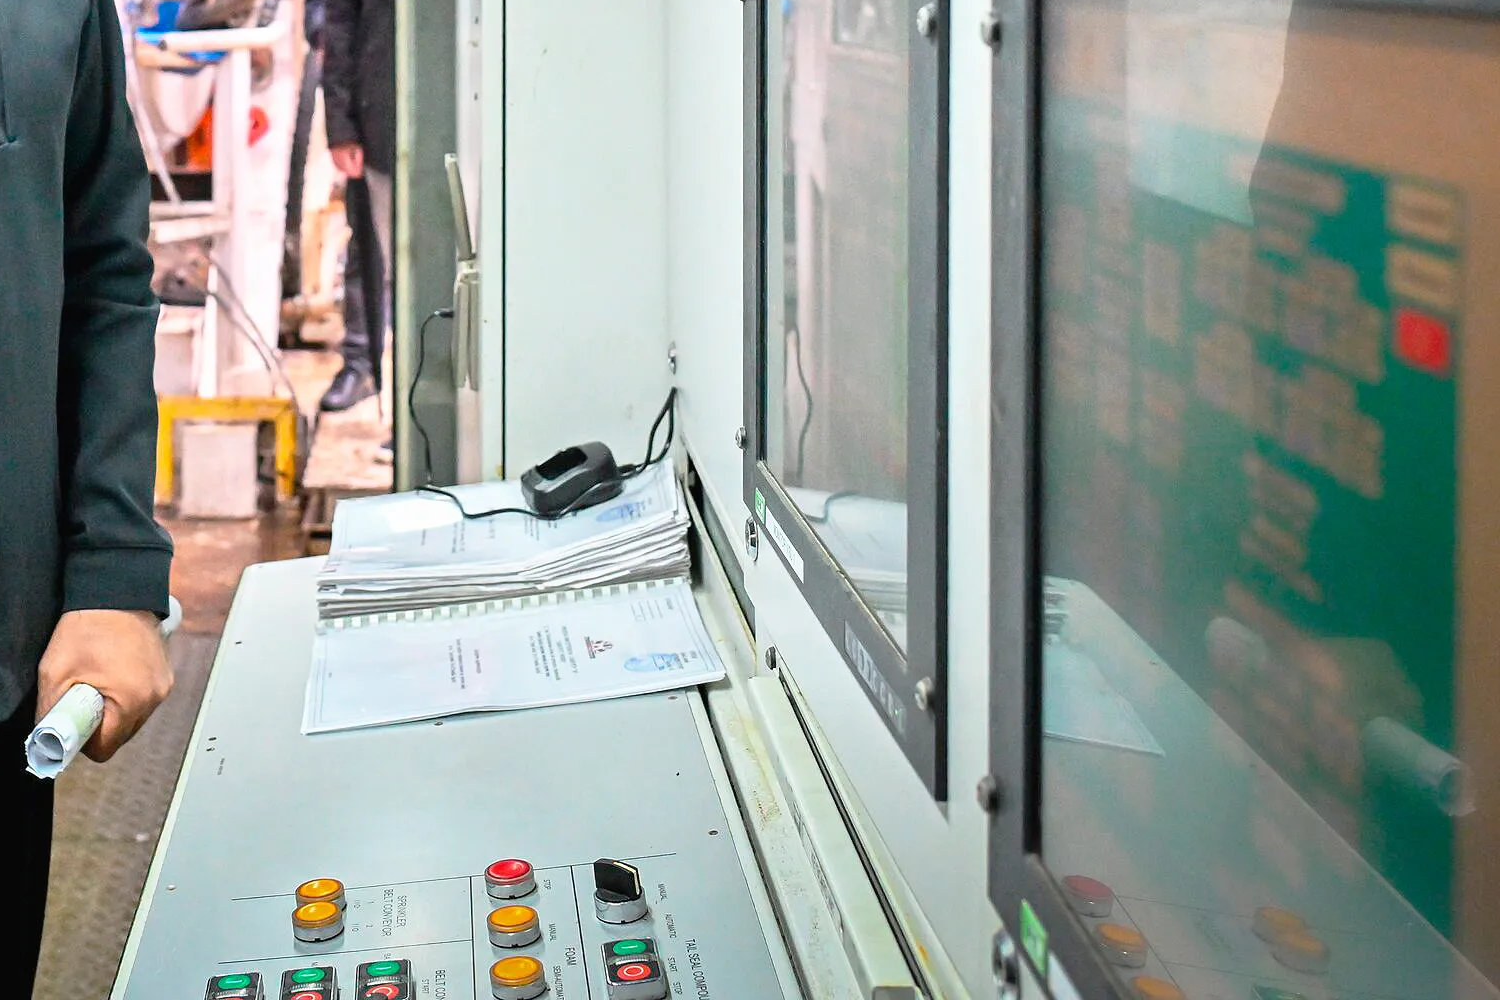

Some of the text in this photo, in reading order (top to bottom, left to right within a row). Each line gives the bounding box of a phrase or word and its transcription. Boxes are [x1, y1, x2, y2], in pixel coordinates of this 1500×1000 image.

[382, 889, 394, 937] BELT CONVEYOR
[396, 895, 407, 928] SPRINKLER
[684, 938, 696, 953] TAIL
[565, 947, 577, 966] FOAM
[667, 957, 678, 972] START
[688, 953, 702, 970] SEAL
[435, 969, 446, 986] BELT
[421, 979, 430, 994] START
[673, 982, 683, 995] STOP
